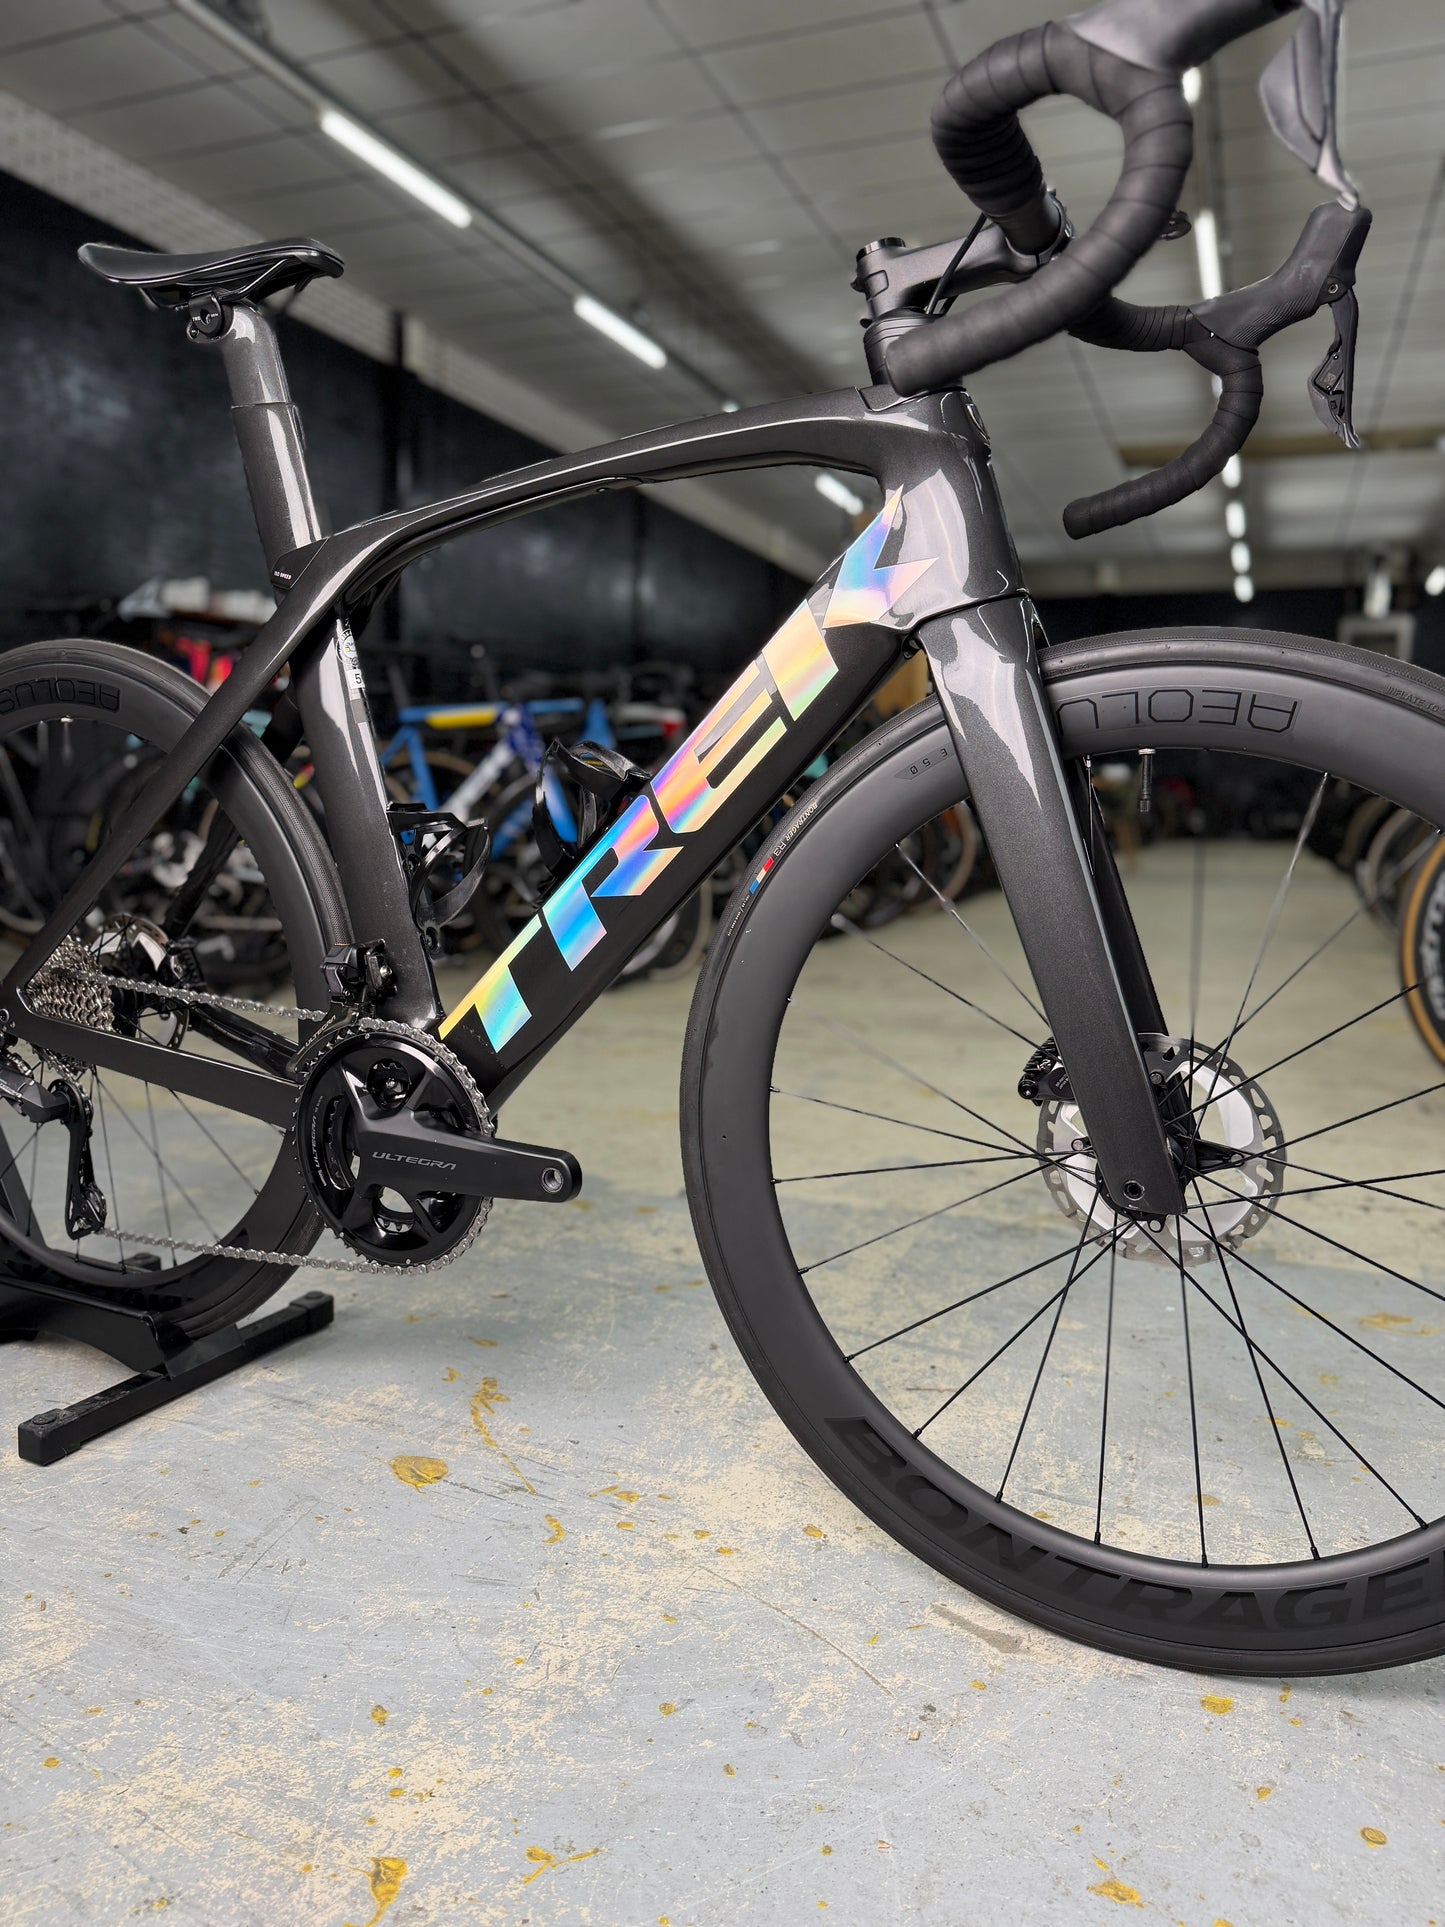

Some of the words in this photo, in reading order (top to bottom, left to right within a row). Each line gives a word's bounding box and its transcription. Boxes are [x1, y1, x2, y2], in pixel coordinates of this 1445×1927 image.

[0, 679, 121, 715] AEOLUS
[1056, 688, 1298, 737] AEOLU
[438, 484, 939, 1053] TREK
[785, 801, 818, 842] BONTRAGER
[773, 841, 787, 857] R3
[305, 1014, 336, 1048] ULTEGRA
[311, 1115, 321, 1169] ULTEGRA
[371, 1150, 457, 1171] ULTEGRA
[823, 1416, 1445, 1631] BONTRAGE
